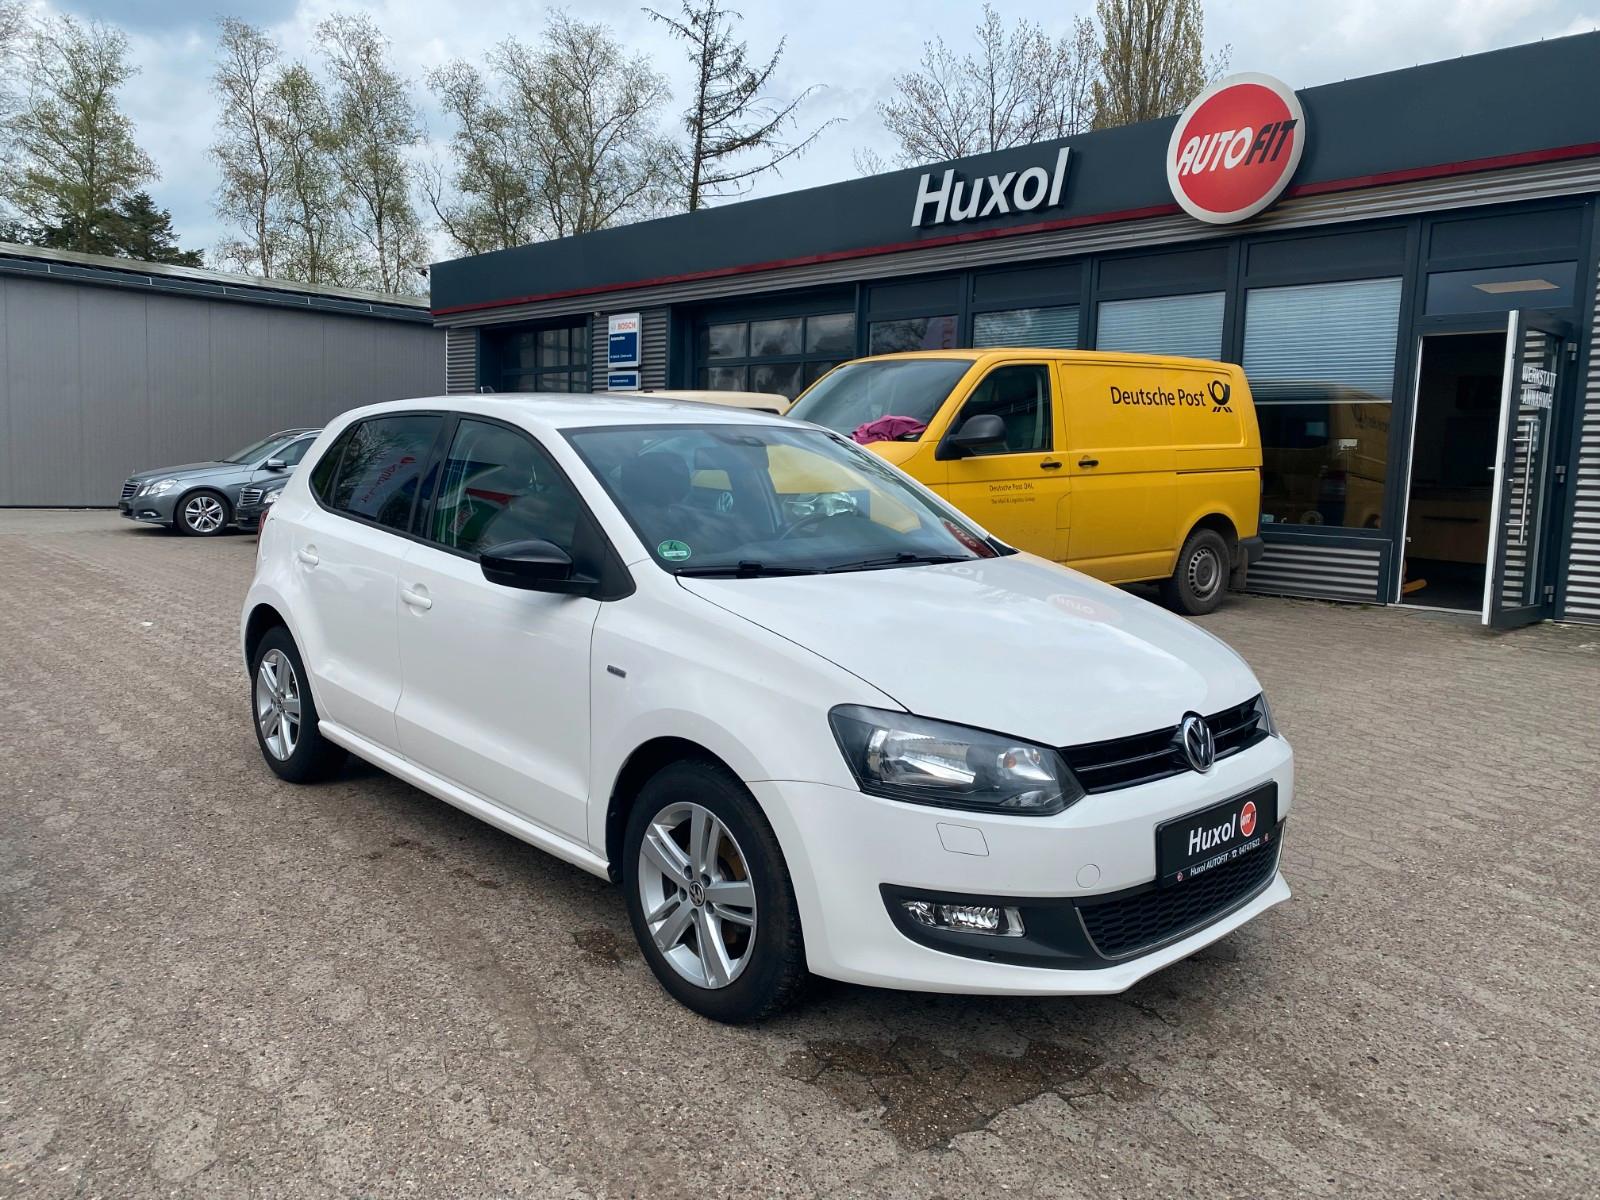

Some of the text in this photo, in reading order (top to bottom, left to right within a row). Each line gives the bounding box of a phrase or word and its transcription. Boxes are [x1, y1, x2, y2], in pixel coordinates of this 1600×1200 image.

[1177, 118, 1299, 177] AUTOFIT
[911, 146, 1071, 228] Huxol
[1522, 366, 1557, 388] WERKSTATT
[1110, 385, 1206, 407] Deutsche Post
[1187, 813, 1237, 856] Huxol
[1205, 852, 1229, 870] AUTOFIT
